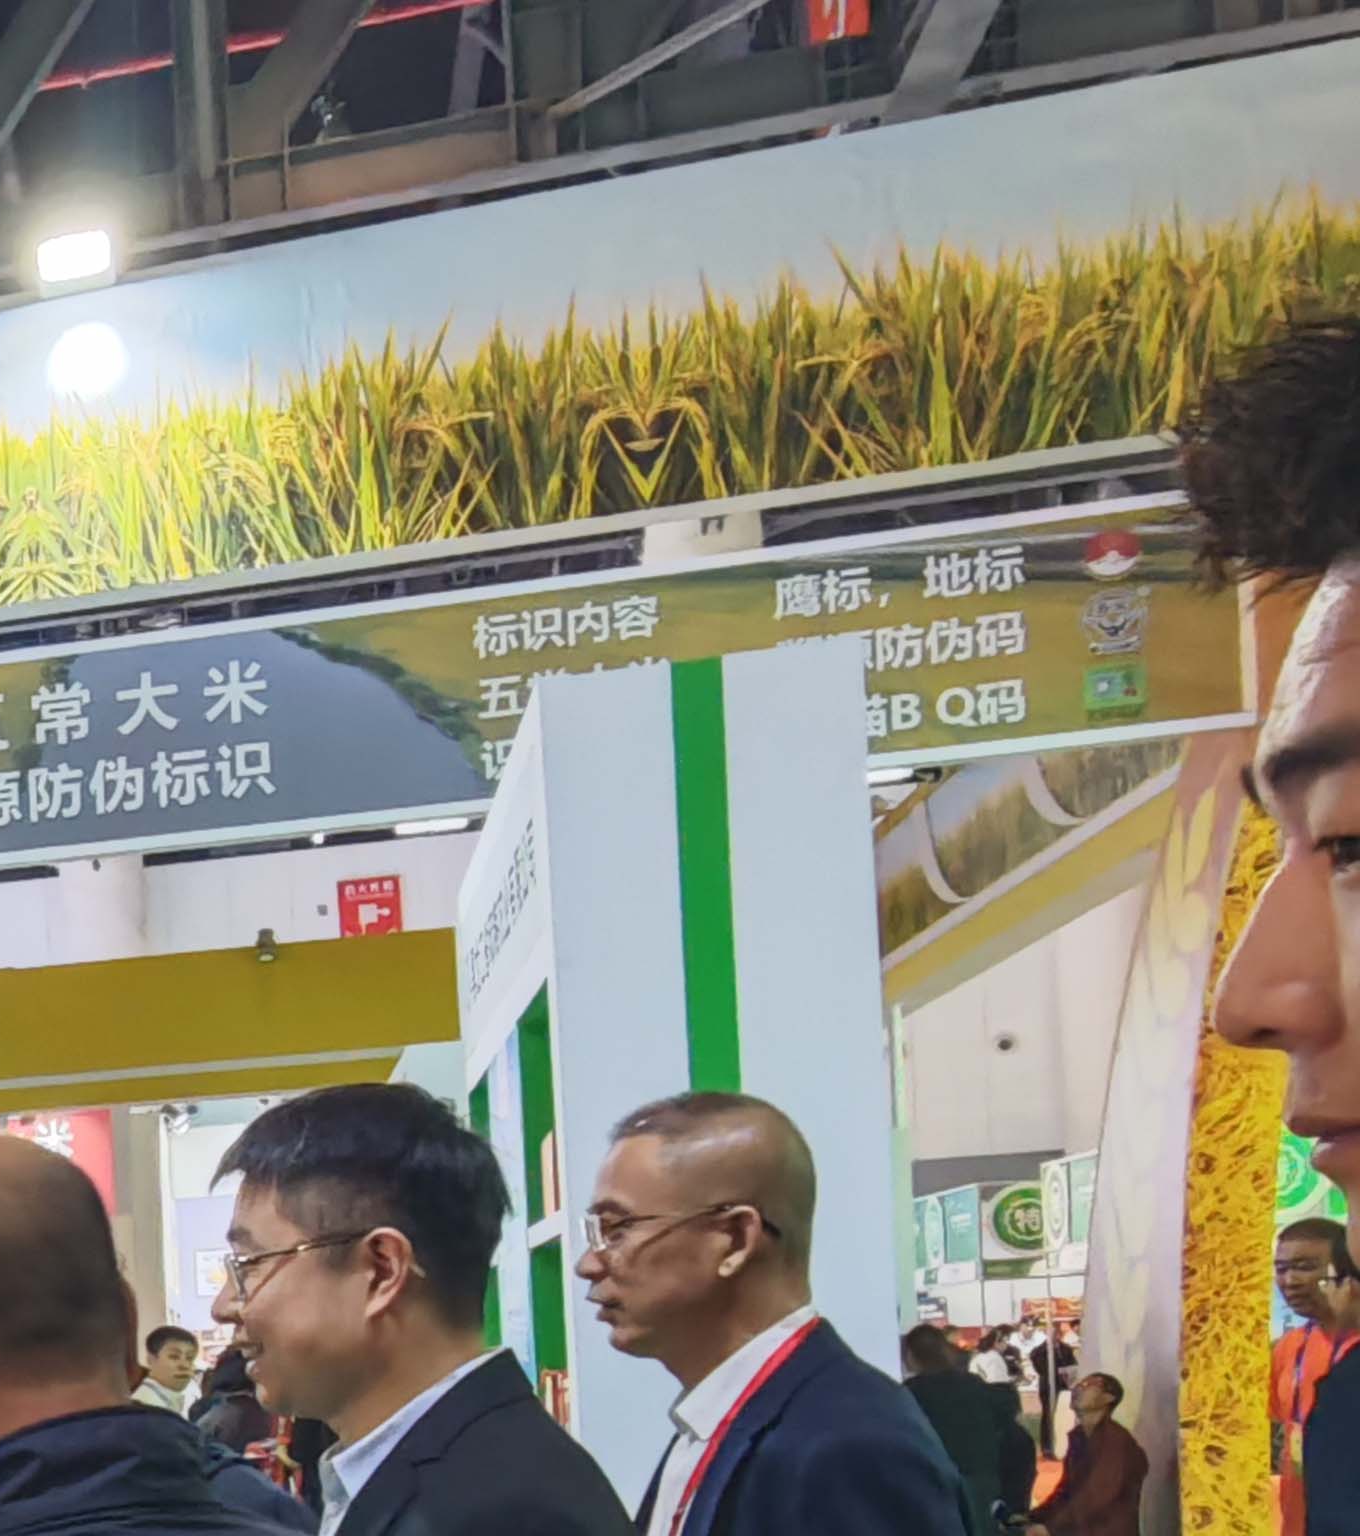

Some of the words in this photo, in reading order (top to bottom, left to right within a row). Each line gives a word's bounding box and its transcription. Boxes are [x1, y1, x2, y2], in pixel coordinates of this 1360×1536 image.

[473, 596, 660, 659] 标识内容
[775, 611, 1026, 672] 防伪码
